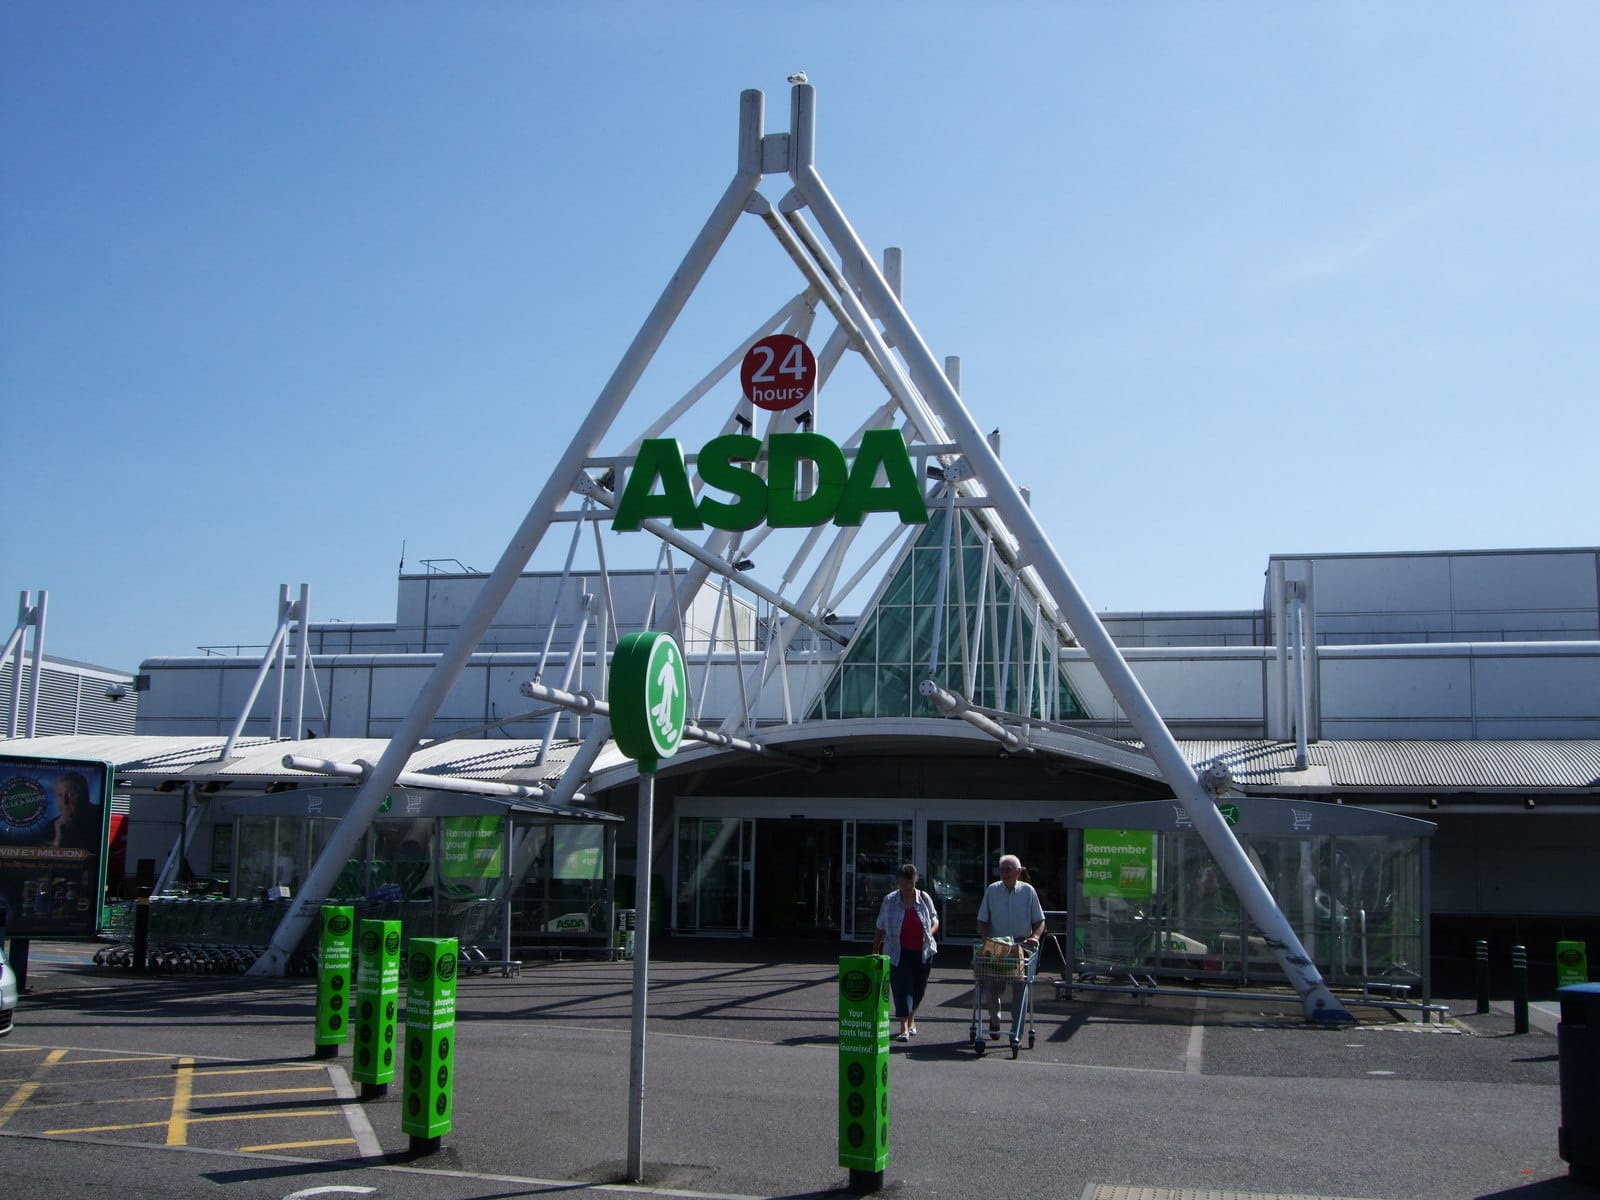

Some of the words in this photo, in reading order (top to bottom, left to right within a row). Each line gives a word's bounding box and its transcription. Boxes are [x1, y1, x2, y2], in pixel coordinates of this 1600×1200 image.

[752, 344, 807, 383] 24
[752, 385, 804, 401] hours
[611, 428, 930, 532] ASDA
[37, 849, 83, 858] MILLION
[1086, 844, 1147, 855] Remember
[1086, 856, 1111, 866] your
[1086, 868, 1112, 880] bags
[556, 918, 586, 929] ASDA
[848, 1008, 863, 1017] Your
[841, 1019, 872, 1030] shopping
[840, 1028, 856, 1037] costs
